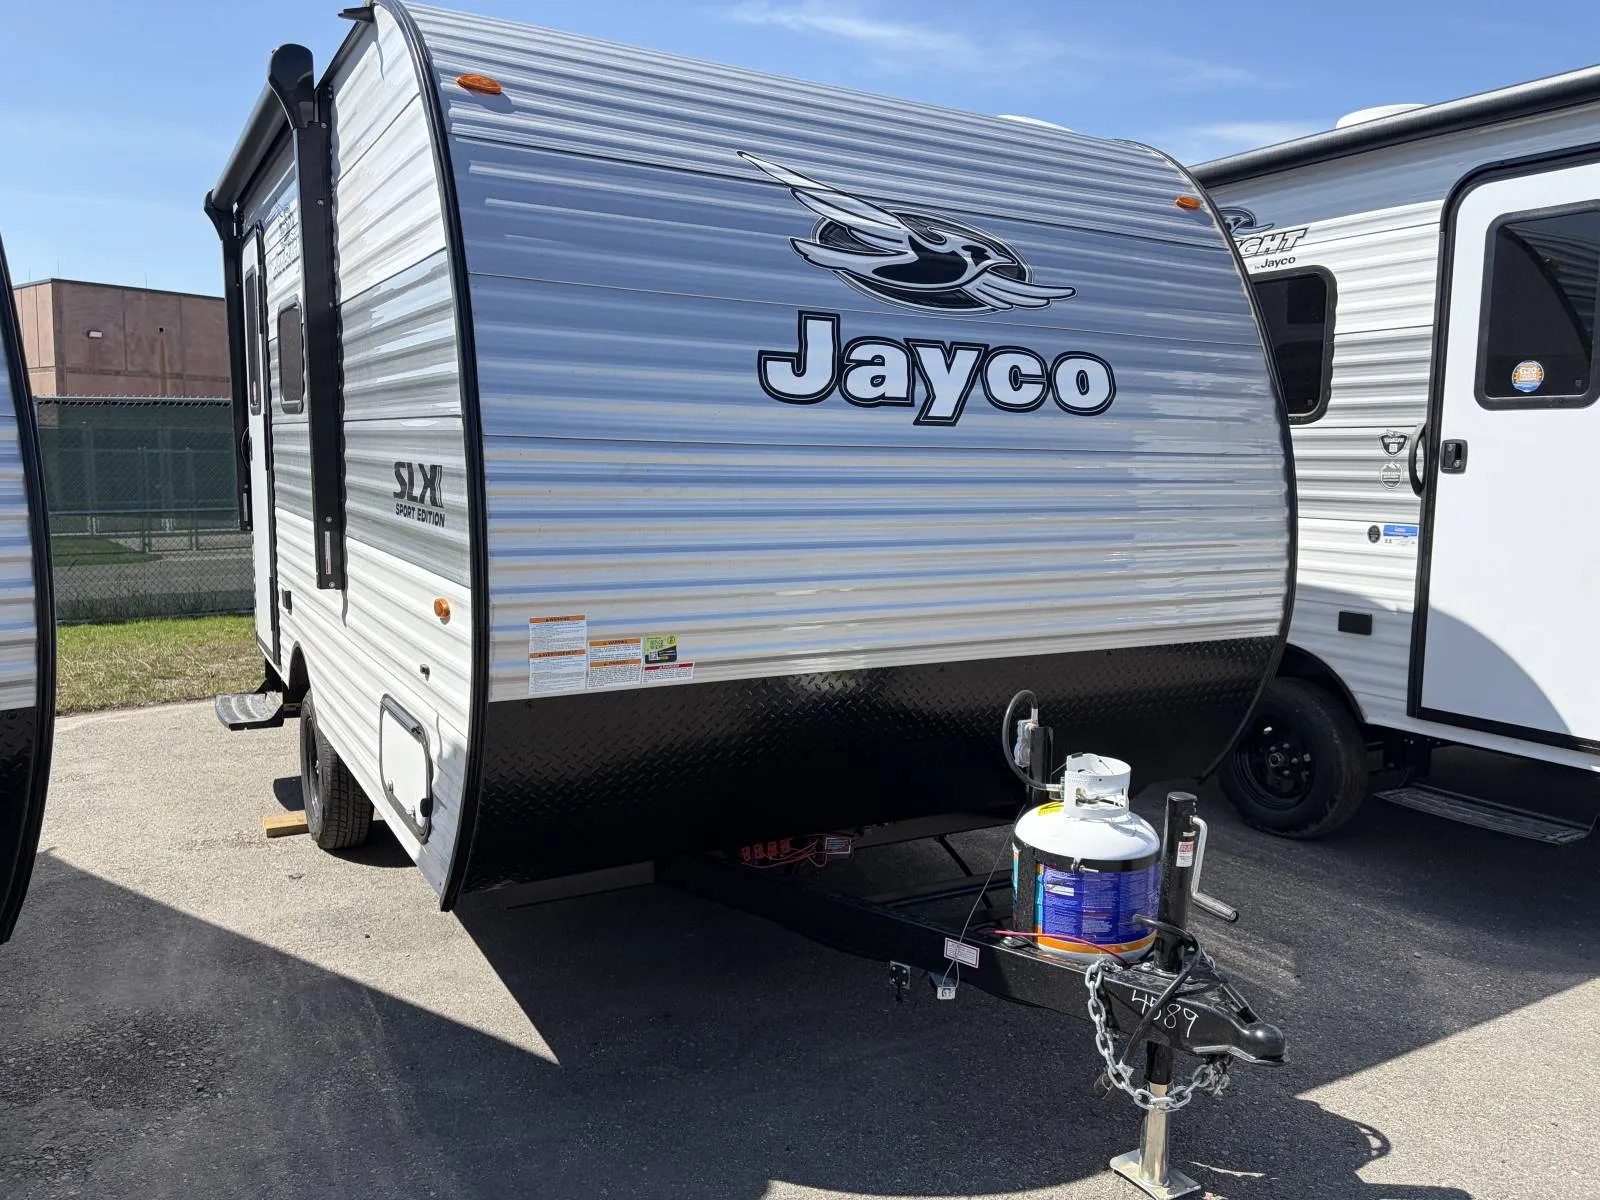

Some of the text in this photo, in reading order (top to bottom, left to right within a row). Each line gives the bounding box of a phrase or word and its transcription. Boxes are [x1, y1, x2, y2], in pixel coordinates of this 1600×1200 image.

[1260, 256, 1296, 269] Jayco
[757, 310, 1117, 426] Jayco
[395, 503, 445, 527] SPORT EDITION
